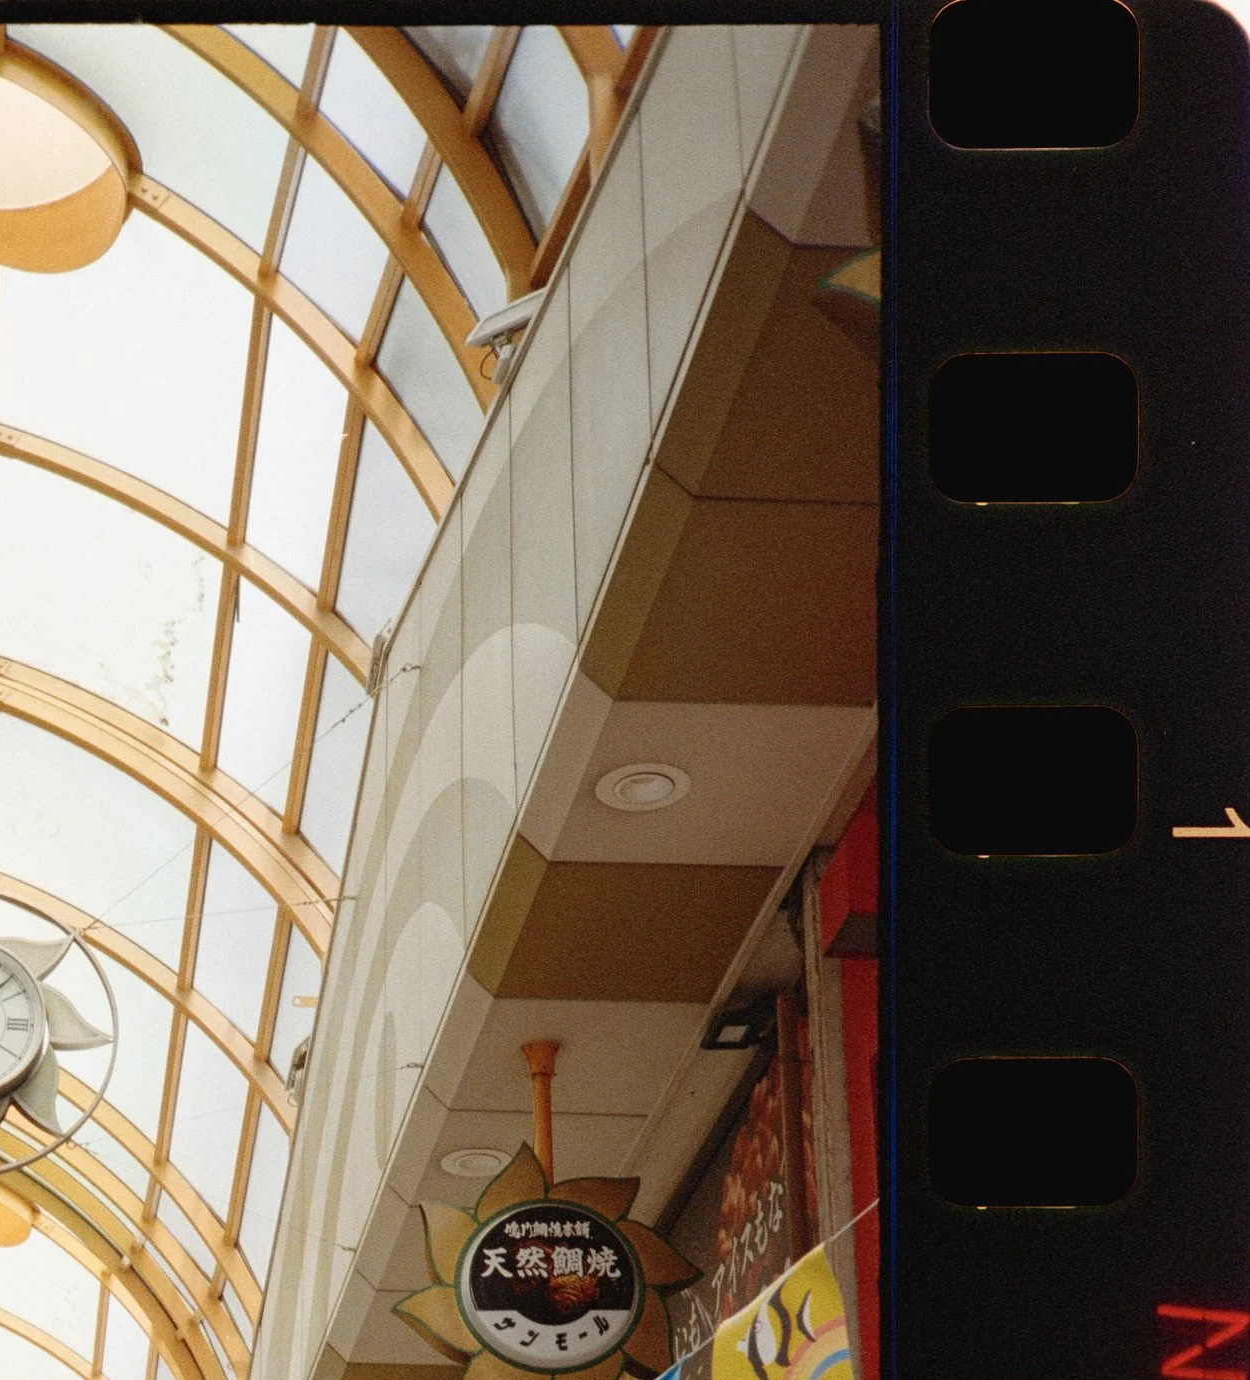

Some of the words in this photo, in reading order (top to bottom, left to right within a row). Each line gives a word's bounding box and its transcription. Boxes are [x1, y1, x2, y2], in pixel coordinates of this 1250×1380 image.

[481, 1245, 622, 1280] 天然鯛焼
[493, 1315, 610, 1351] サンモール
